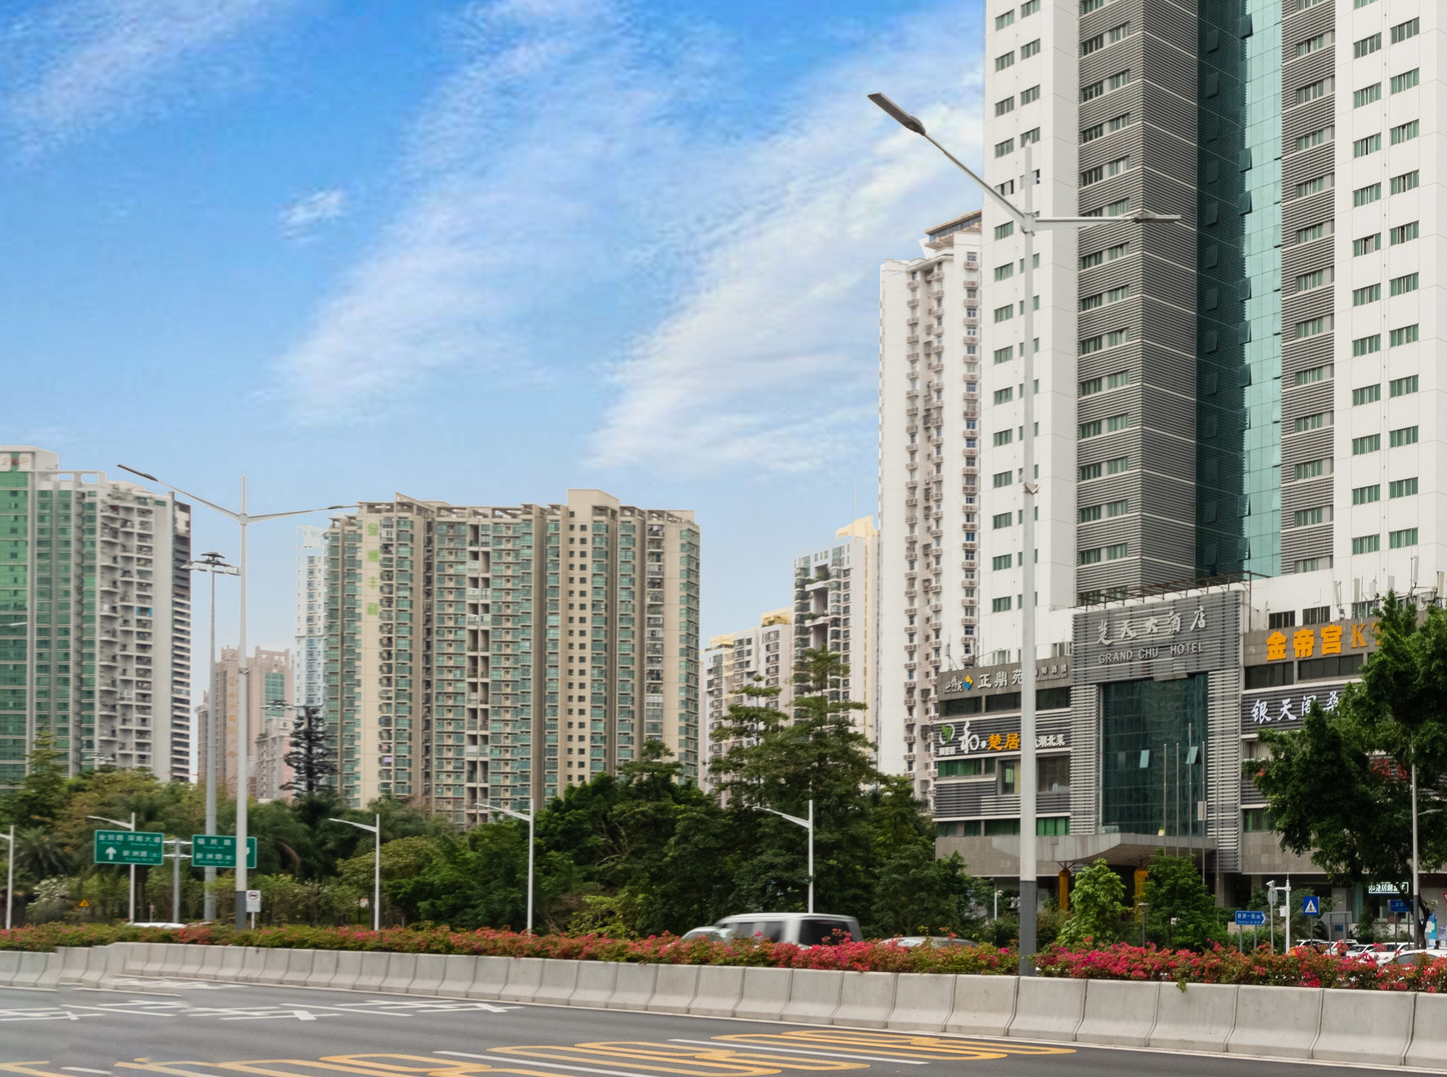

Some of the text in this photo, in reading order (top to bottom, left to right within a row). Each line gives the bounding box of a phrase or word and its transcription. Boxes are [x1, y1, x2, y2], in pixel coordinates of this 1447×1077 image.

[1098, 642, 1204, 664] GRAND CHU HOTEL
